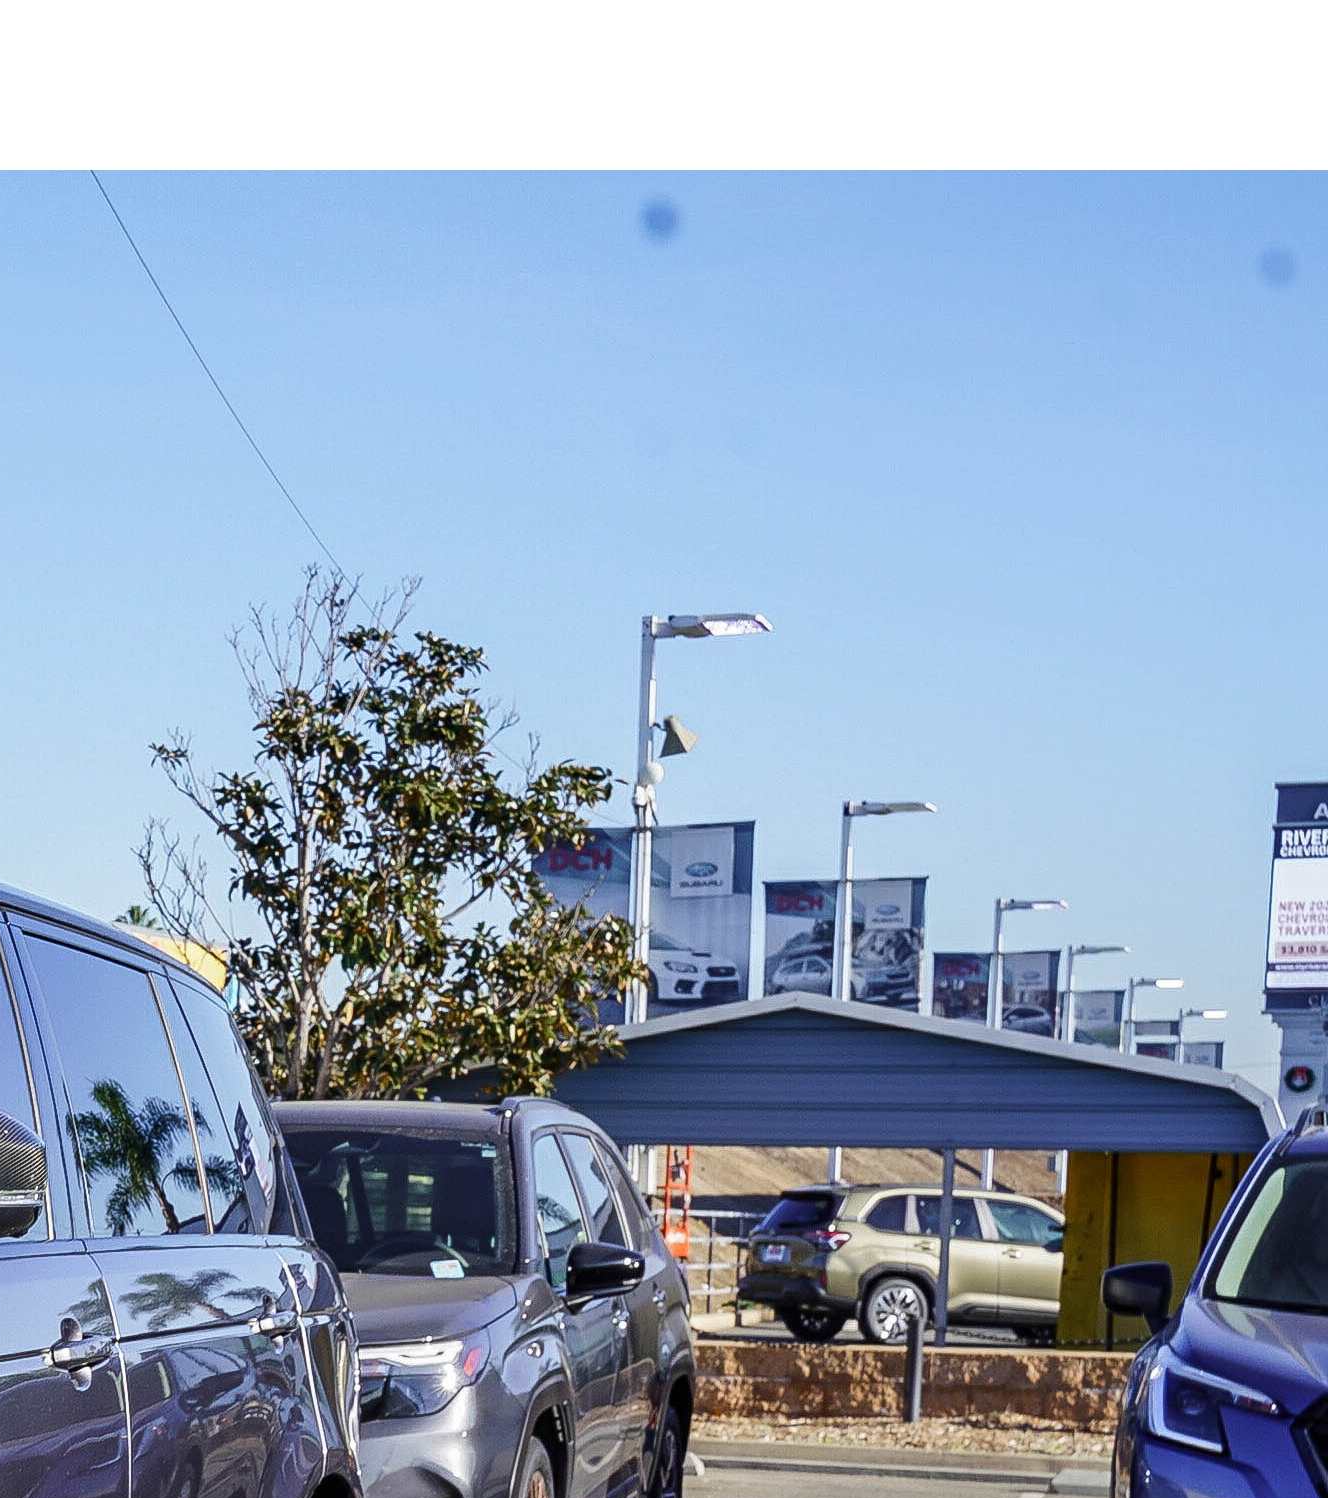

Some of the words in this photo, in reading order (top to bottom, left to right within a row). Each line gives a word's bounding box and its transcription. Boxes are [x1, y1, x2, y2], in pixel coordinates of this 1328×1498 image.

[1279, 845, 1328, 858] CHEVRO
[548, 847, 613, 871] DCH
[679, 879, 723, 888] SUBARU
[1278, 913, 1328, 924] CHEVRO
[1278, 926, 1328, 936] TRAVER
